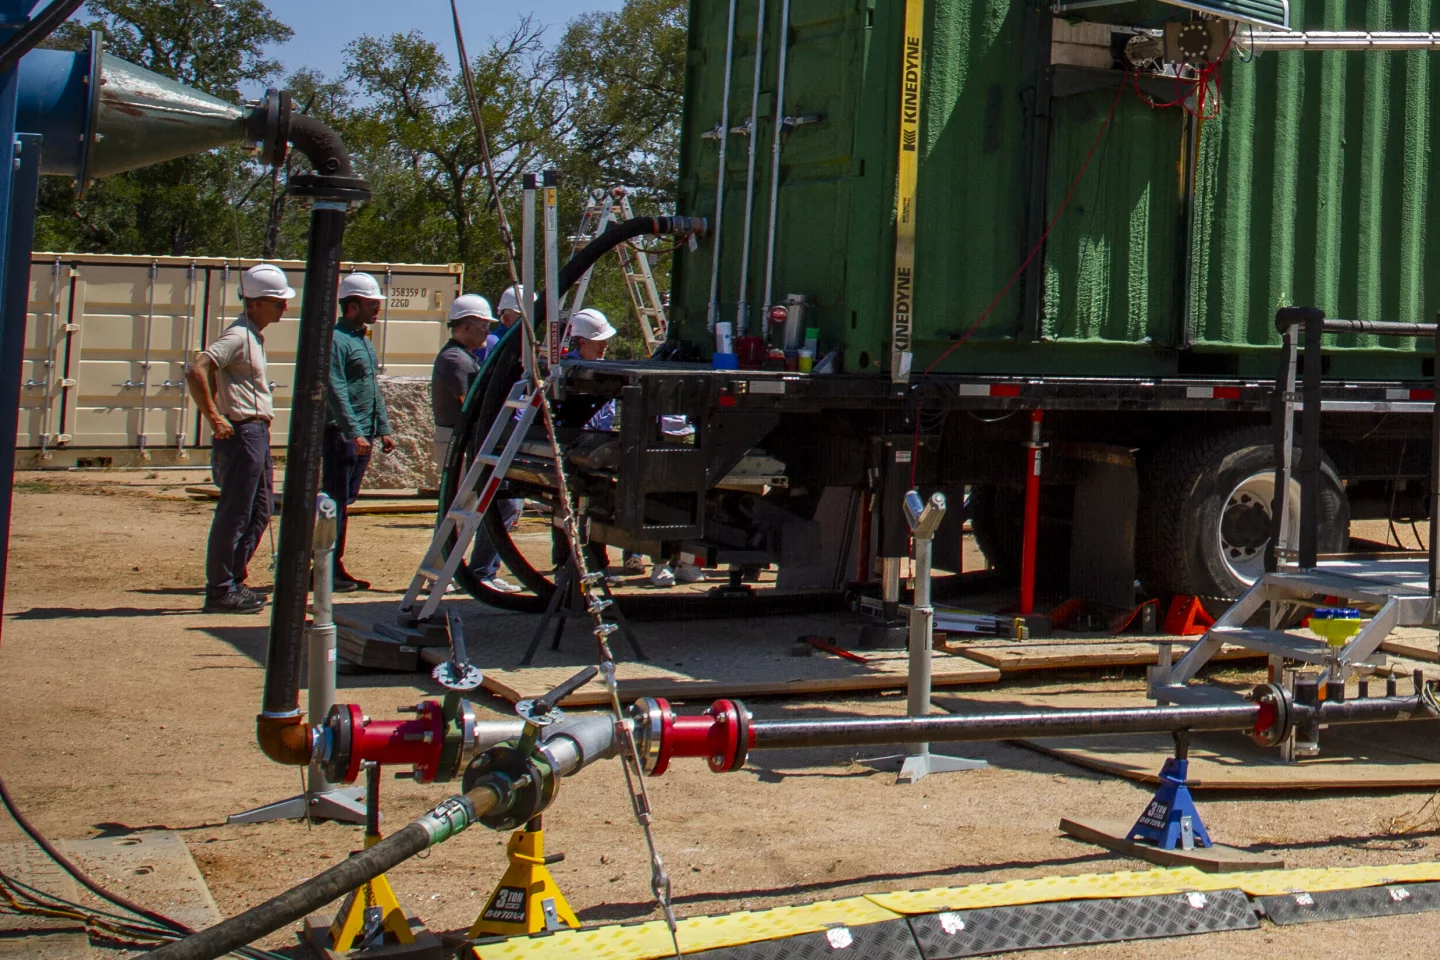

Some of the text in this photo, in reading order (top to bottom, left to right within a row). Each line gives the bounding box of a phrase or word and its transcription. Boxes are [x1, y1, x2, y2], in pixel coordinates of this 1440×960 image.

[904, 36, 919, 124] KINEDYNE
[391, 287, 419, 297] 358359
[895, 267, 911, 352] KINEDYNE
[1147, 801, 1158, 817] 3
[495, 888, 509, 908] 3
[508, 891, 524, 903] TON
[484, 909, 526, 921] DAYTONA
